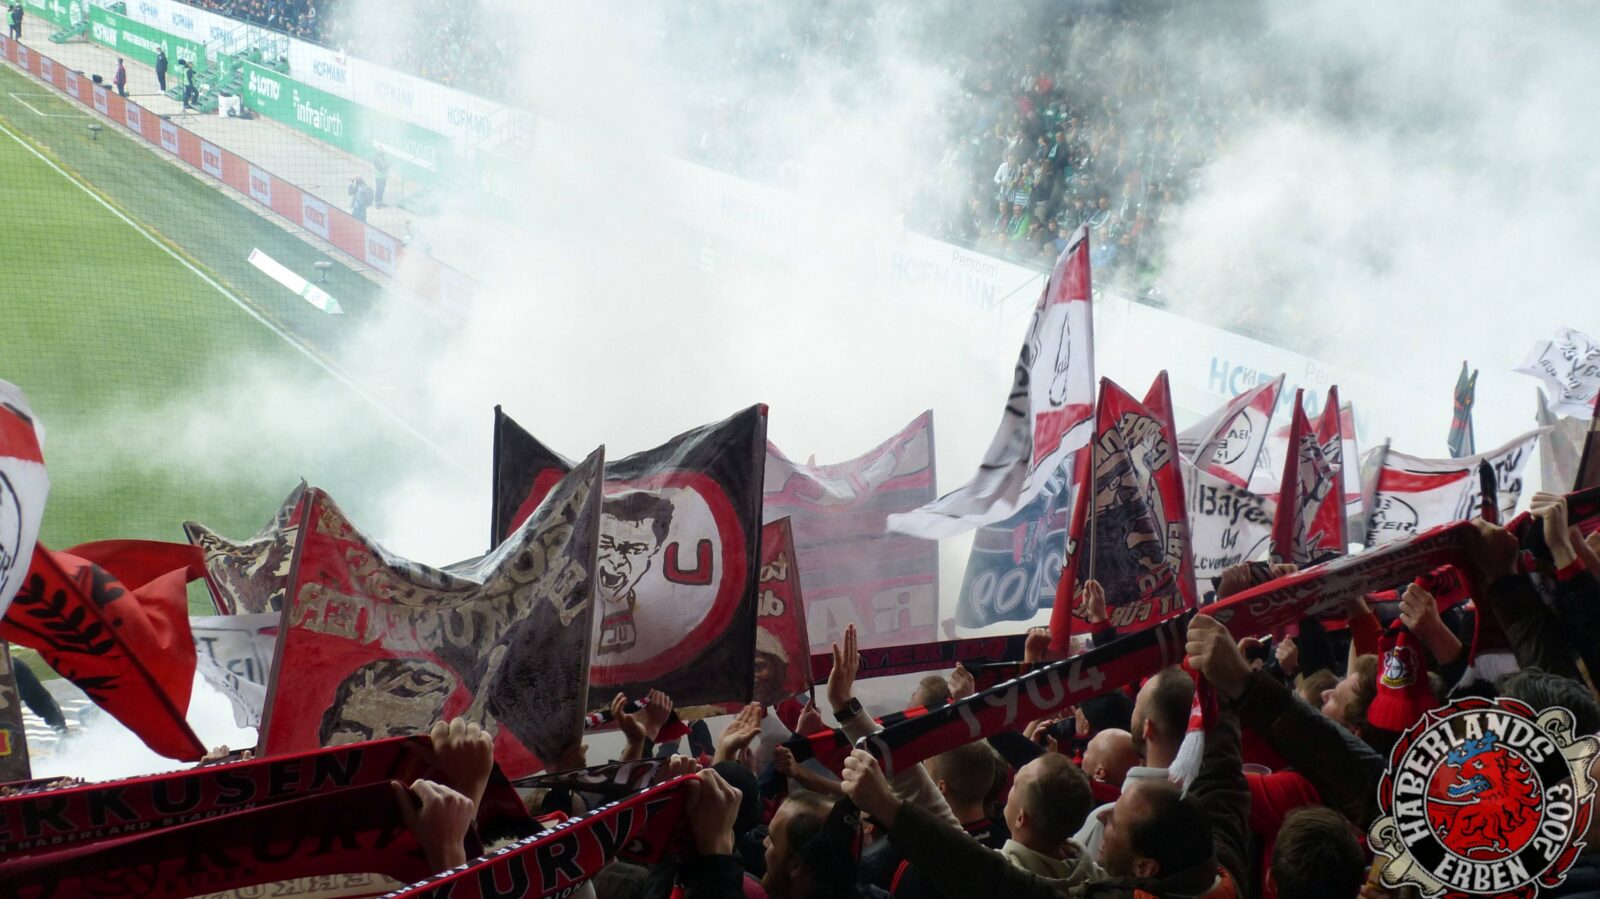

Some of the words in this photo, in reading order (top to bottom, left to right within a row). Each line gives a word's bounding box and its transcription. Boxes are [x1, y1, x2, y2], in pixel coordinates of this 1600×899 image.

[257, 75, 280, 101] LOTTO
[313, 60, 346, 84] HOFMANN
[296, 101, 343, 138] infrafürth
[448, 104, 492, 137] HOFMANN
[952, 249, 1000, 277] Personal
[891, 253, 998, 312] HOFMANN
[957, 658, 1106, 738] 1904
